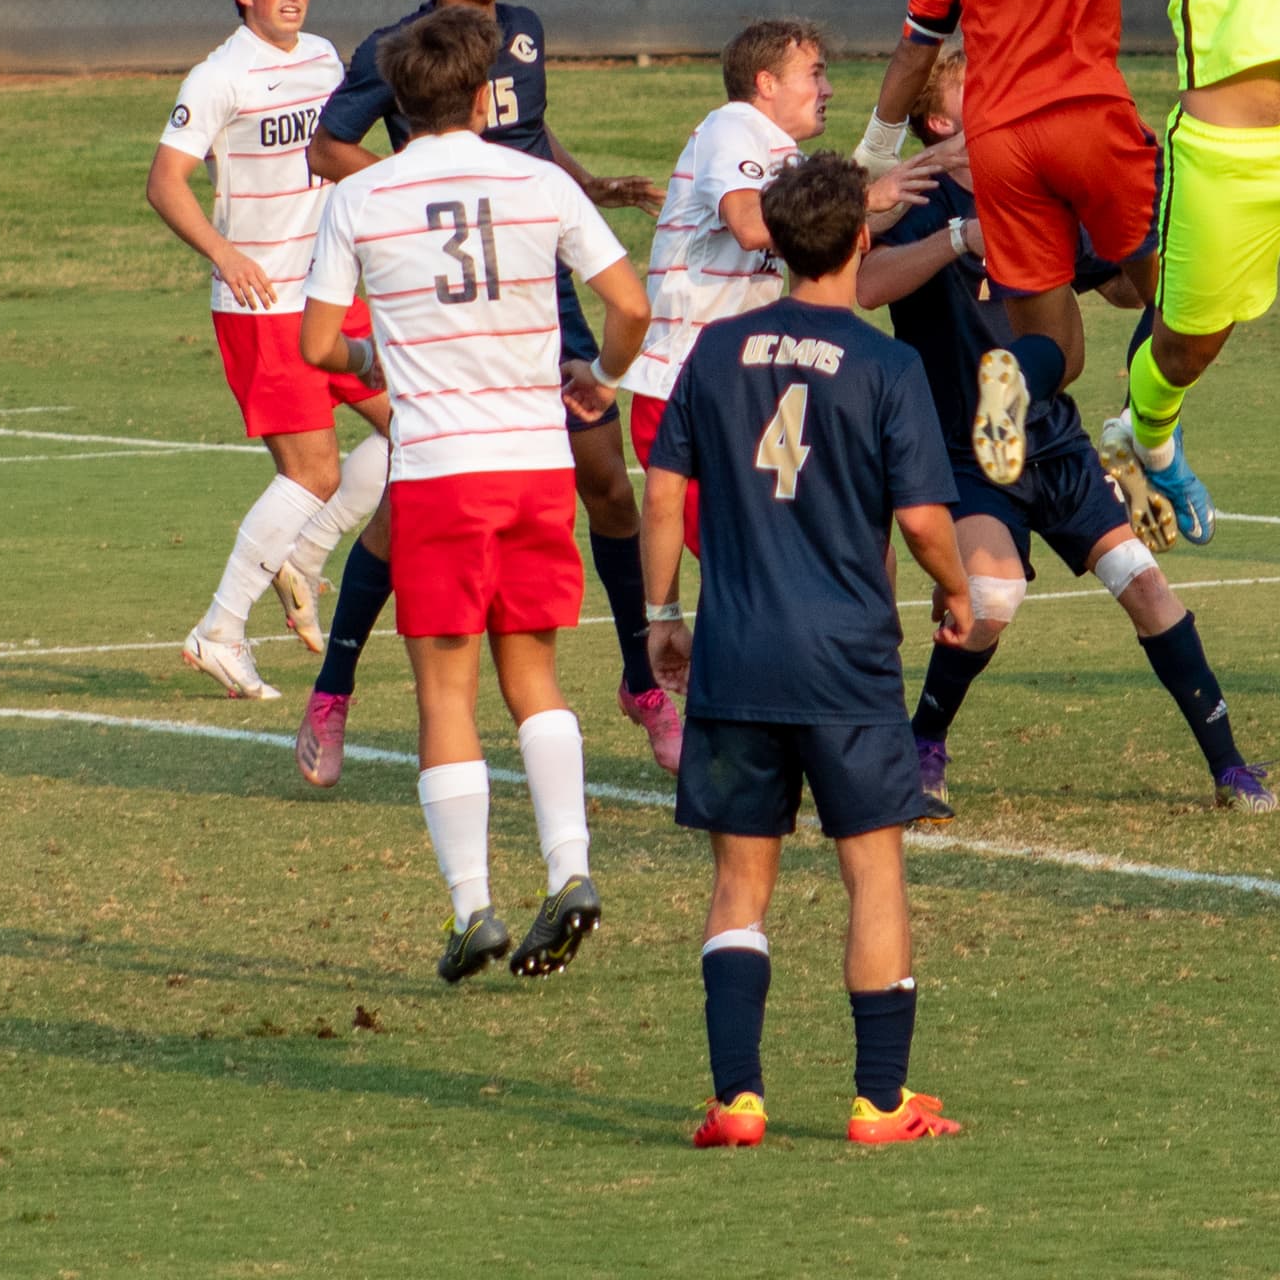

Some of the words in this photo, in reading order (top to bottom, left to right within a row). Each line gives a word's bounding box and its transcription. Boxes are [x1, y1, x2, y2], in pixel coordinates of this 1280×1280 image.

[261, 105, 325, 147] GONZ
[488, 76, 519, 128] 15
[425, 197, 500, 305] 31
[742, 334, 779, 365] UC
[774, 334, 845, 376] DAVIS
[755, 383, 811, 501] 4
